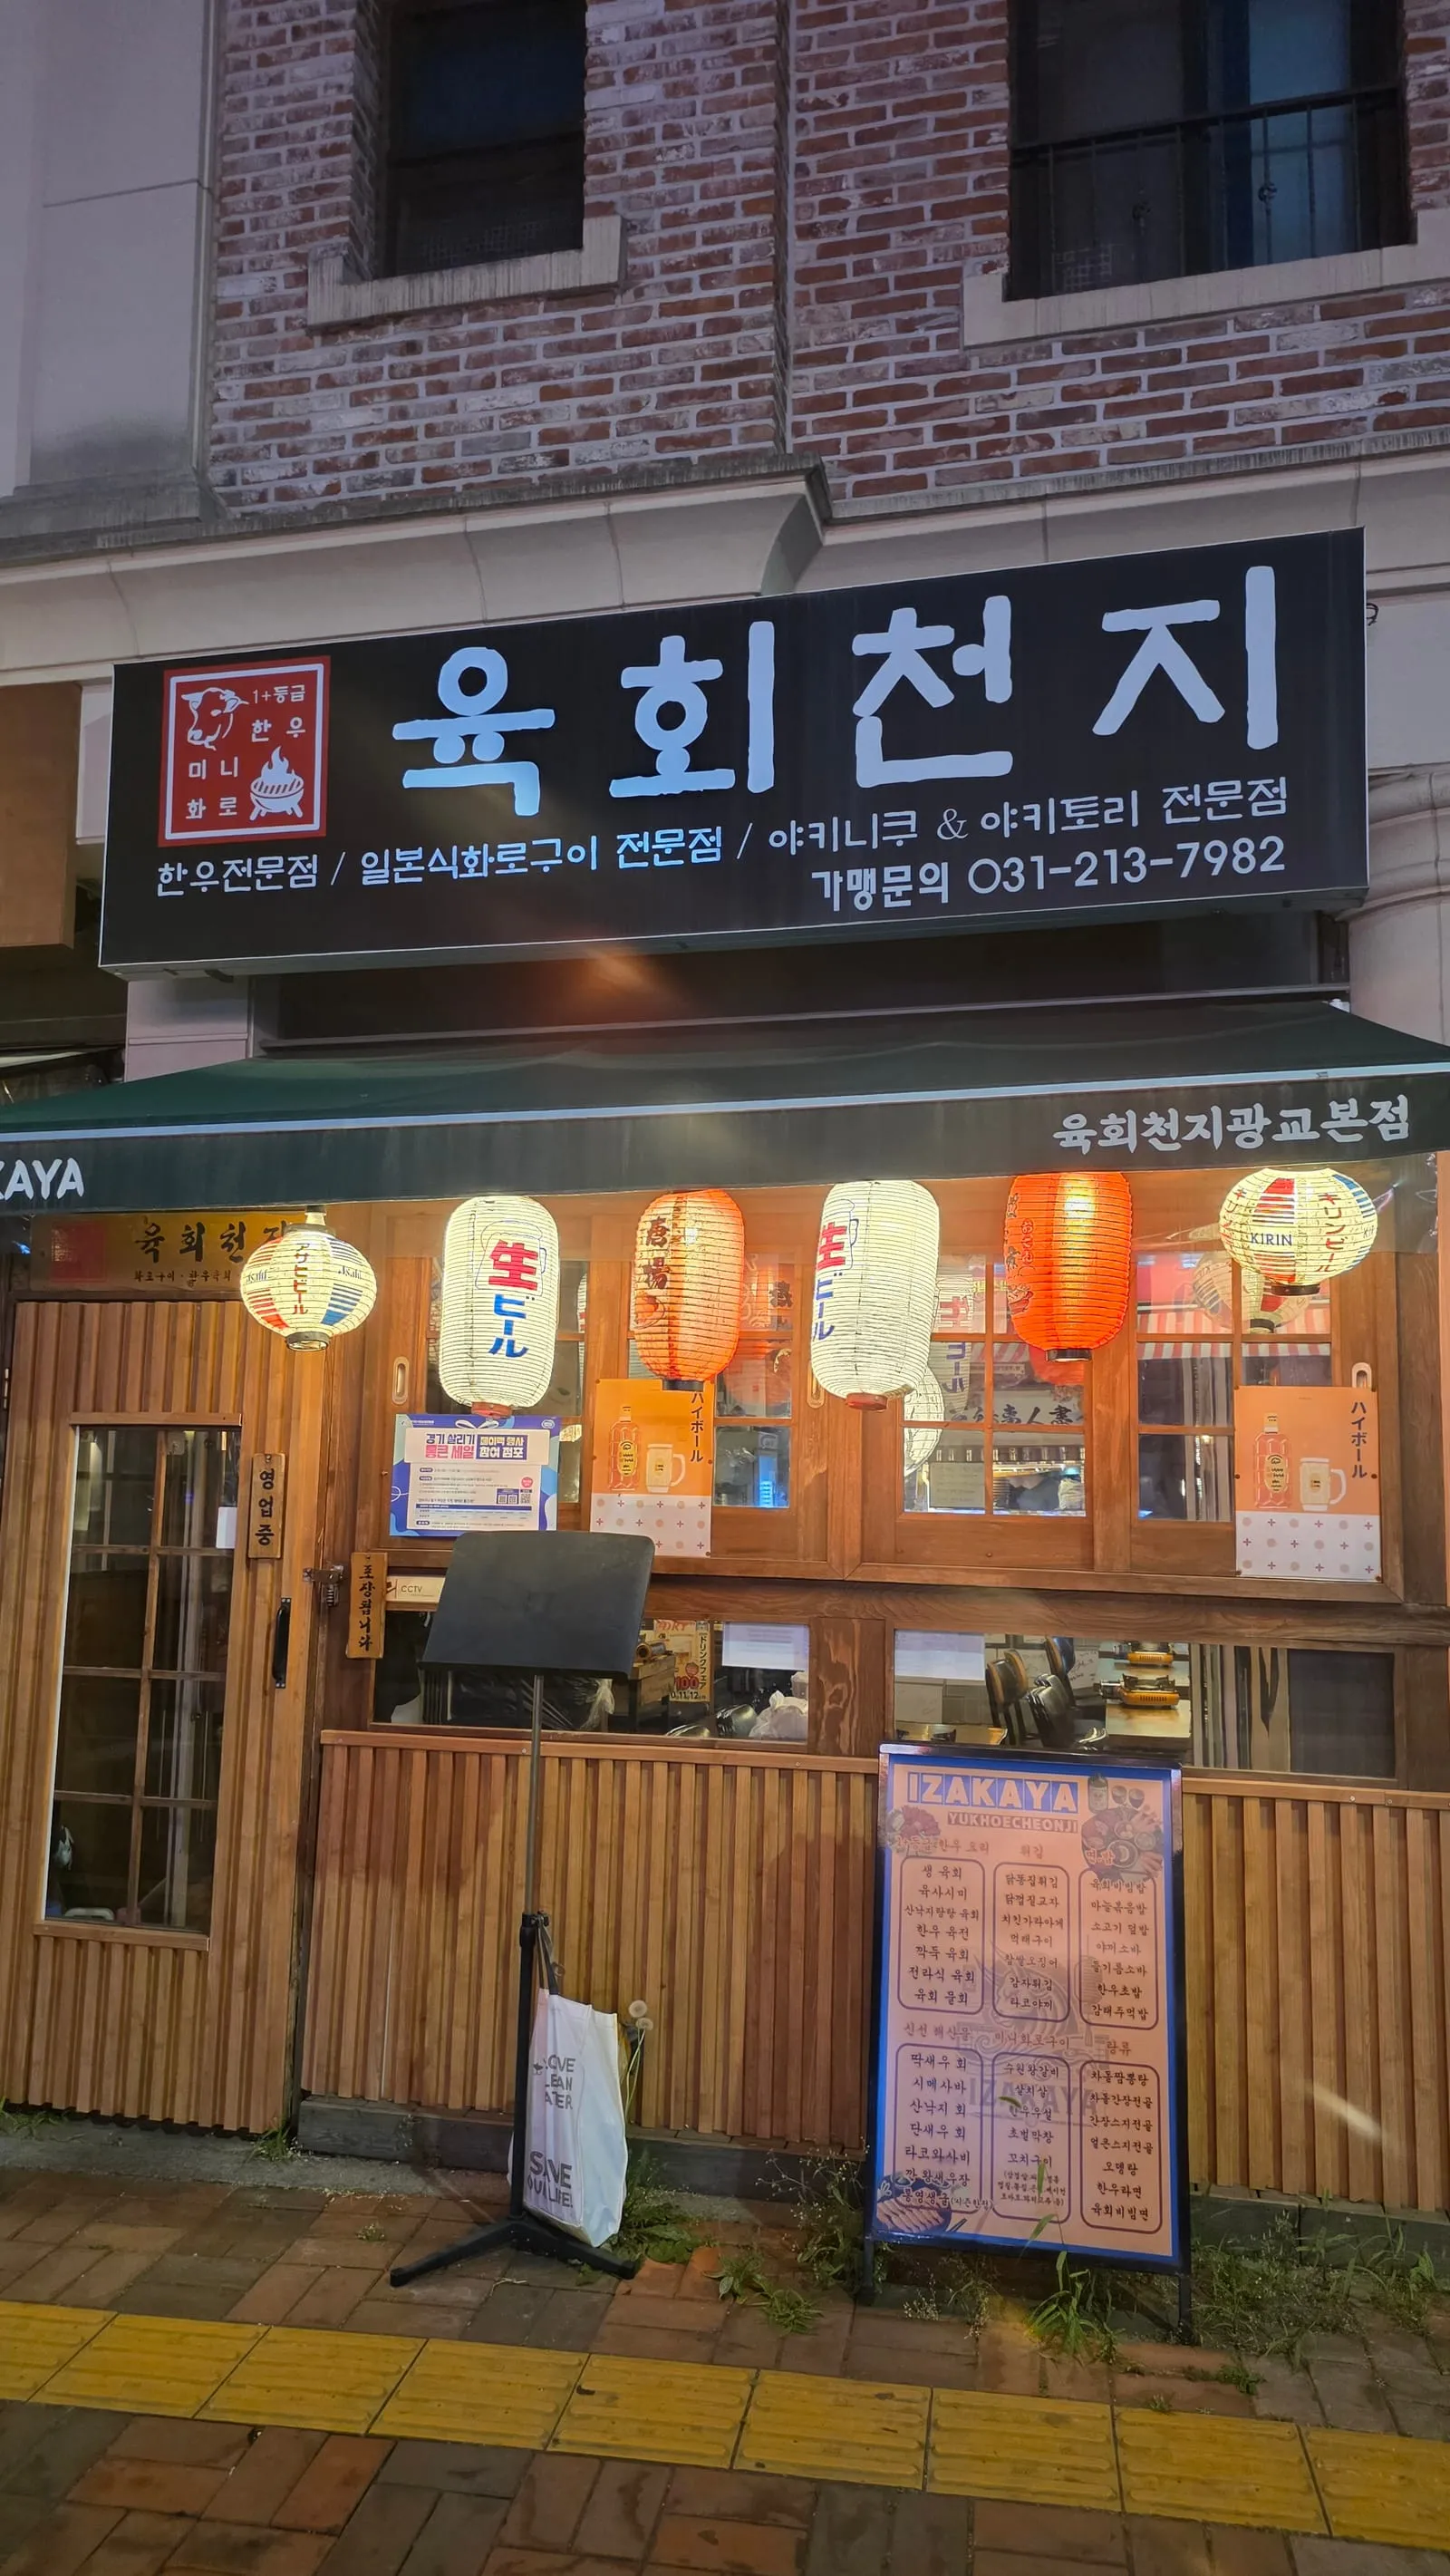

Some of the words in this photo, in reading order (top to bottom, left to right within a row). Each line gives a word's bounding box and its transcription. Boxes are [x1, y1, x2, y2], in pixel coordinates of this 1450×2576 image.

[253, 684, 305, 704] 1+등급
[392, 566, 1279, 816] 육회천지
[251, 716, 305, 743] 한우
[188, 756, 239, 780] 미니
[186, 796, 238, 819] 화로
[157, 854, 319, 897] 한우전문점
[361, 835, 598, 886] 일본식화로구이
[615, 826, 723, 870] 전문점
[768, 810, 919, 859] 야키니쿠
[936, 808, 969, 840] &
[980, 789, 1140, 836] 야키토리
[1162, 776, 1288, 827] 전문점
[811, 861, 950, 912] 가맹문의
[967, 835, 1286, 894] 031-213-7982
[1052, 1094, 1410, 1156] 육회천지광교본점
[1251, 1232, 1293, 1247] KIRIN
[488, 1239, 538, 1359] 生ビール
[1349, 1400, 1368, 1480] ハイボール
[255, 1467, 276, 1546] 영업중
[401, 1584, 422, 1593] CCTV
[358, 1564, 376, 1652] 포장됩니다
[908, 1772, 1078, 1814] IZAKAYA
[948, 1813, 1078, 1833] YUKHOECHEONJI
[938, 1864, 962, 1881] 육회
[918, 1884, 968, 1901] 육사시미
[959, 1908, 980, 1922] 육회
[916, 1922, 941, 1939] 한우
[945, 1925, 970, 1941] 육전
[1090, 1921, 1123, 1934] 소고기
[945, 1947, 970, 1962] 육회
[908, 1965, 945, 1983] 전라식
[951, 1969, 975, 1984] 육회
[1010, 1976, 1053, 1991] 감자튀김
[914, 1988, 938, 2004] 육회
[1097, 1982, 1143, 2000] 한우초밥
[1010, 1997, 1053, 2011] 타코야끼
[911, 2051, 951, 2069] 딱새우
[955, 2057, 967, 2072] 회
[1003, 2062, 1059, 2079] 수원왕갈비
[913, 2075, 967, 2095] 시메사바
[909, 2097, 948, 2116] 산낙지
[955, 2102, 966, 2118] 회
[954, 2126, 966, 2141] 회
[905, 2145, 971, 2166] 타코와사비
[1097, 2181, 1143, 2200] 한우라면
[1090, 2202, 1149, 2222] 육회비빔면
